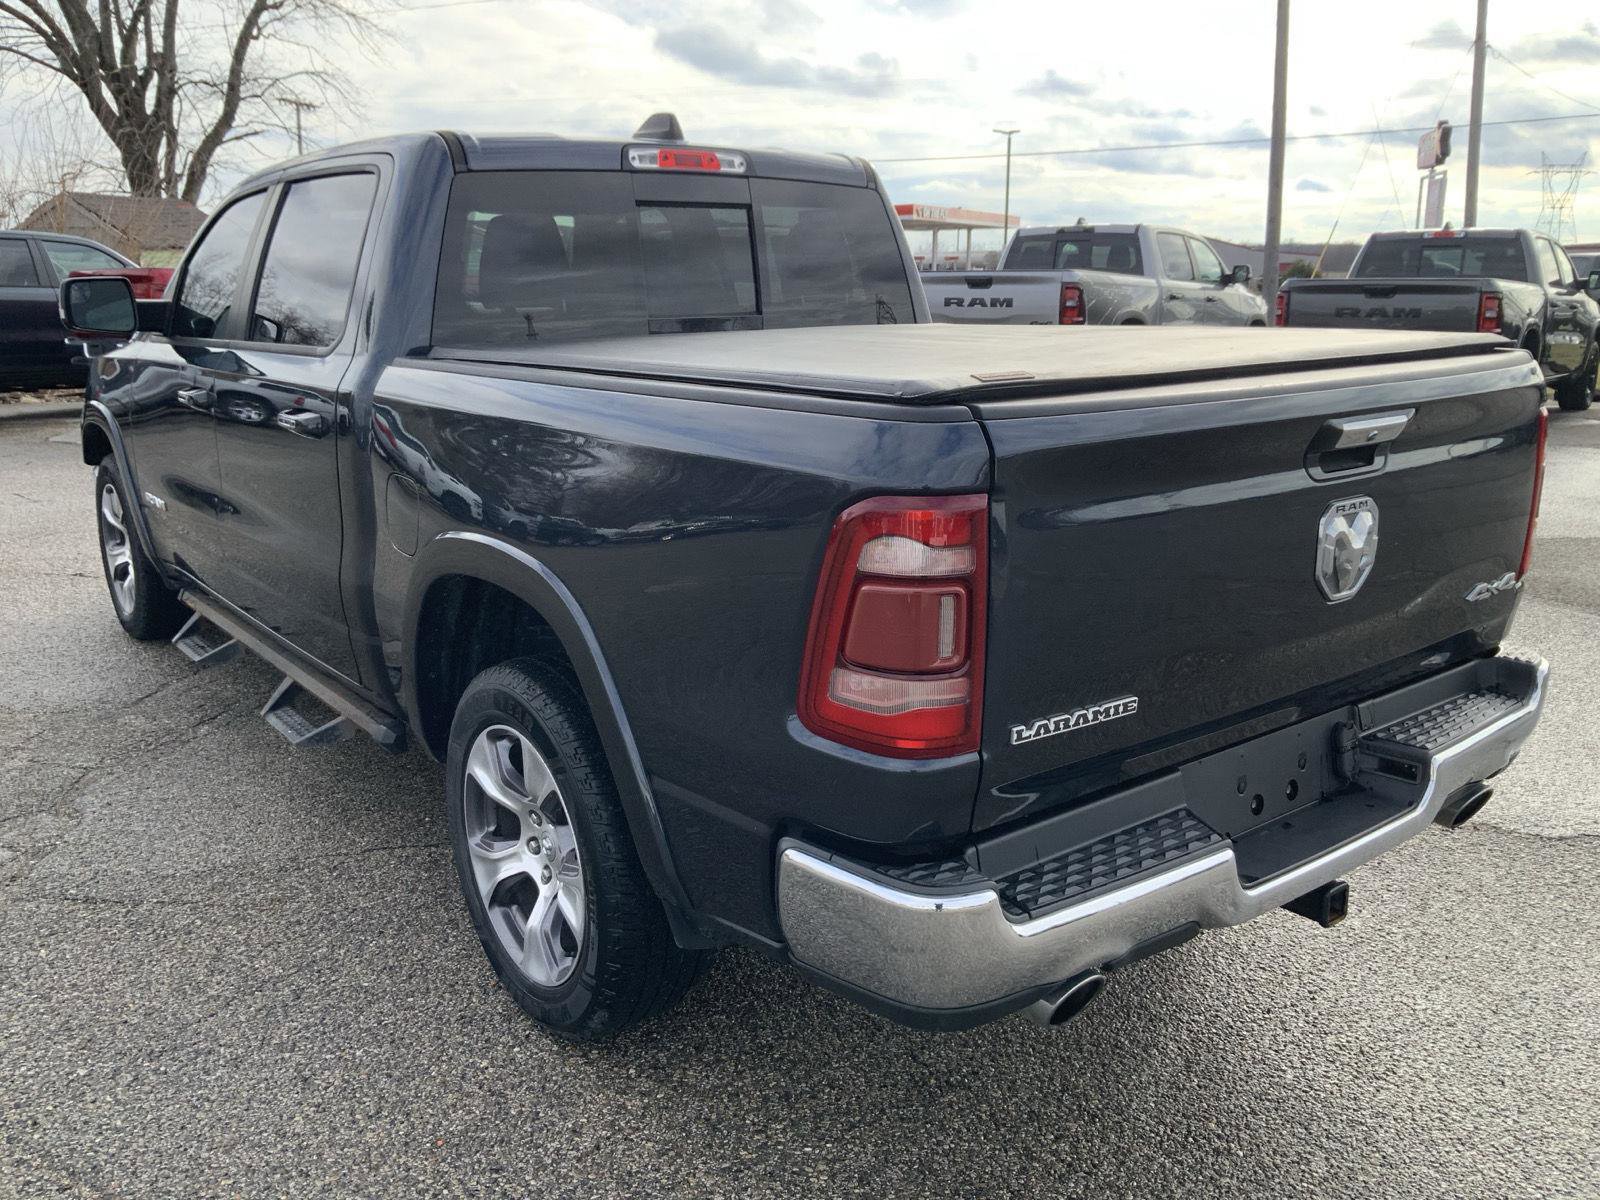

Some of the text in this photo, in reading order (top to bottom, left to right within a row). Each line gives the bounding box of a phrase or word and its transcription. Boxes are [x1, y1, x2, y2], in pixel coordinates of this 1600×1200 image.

[943, 297, 1014, 308] RAM
[1334, 307, 1422, 319] RAM
[1336, 500, 1368, 513] RAM
[1010, 695, 1139, 745] LARAMIE
